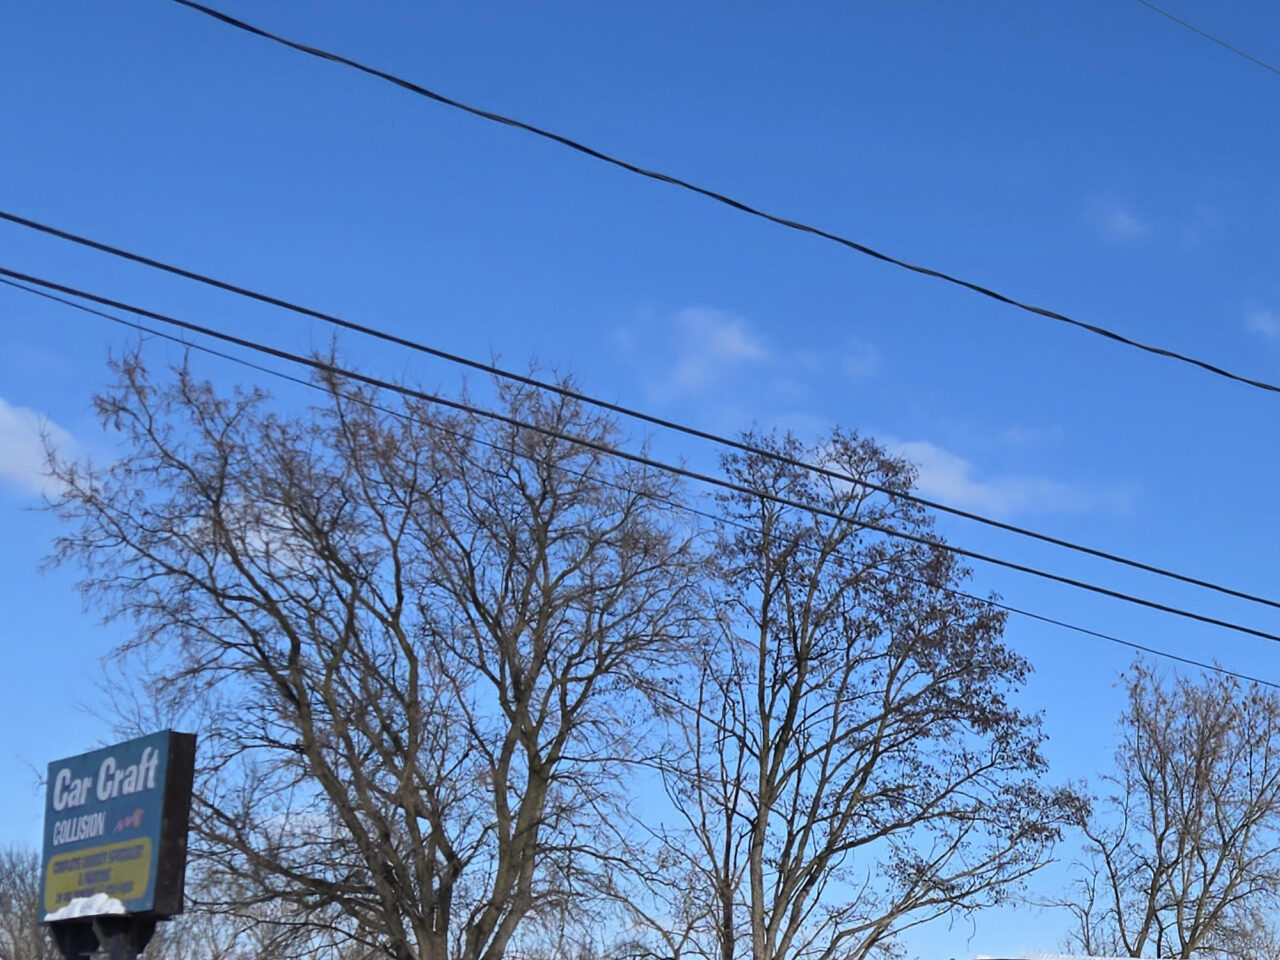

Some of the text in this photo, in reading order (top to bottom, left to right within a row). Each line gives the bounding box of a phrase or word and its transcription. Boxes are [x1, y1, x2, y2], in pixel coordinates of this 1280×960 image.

[53, 746, 159, 811] Car Craft
[53, 811, 106, 846] COLLISION
